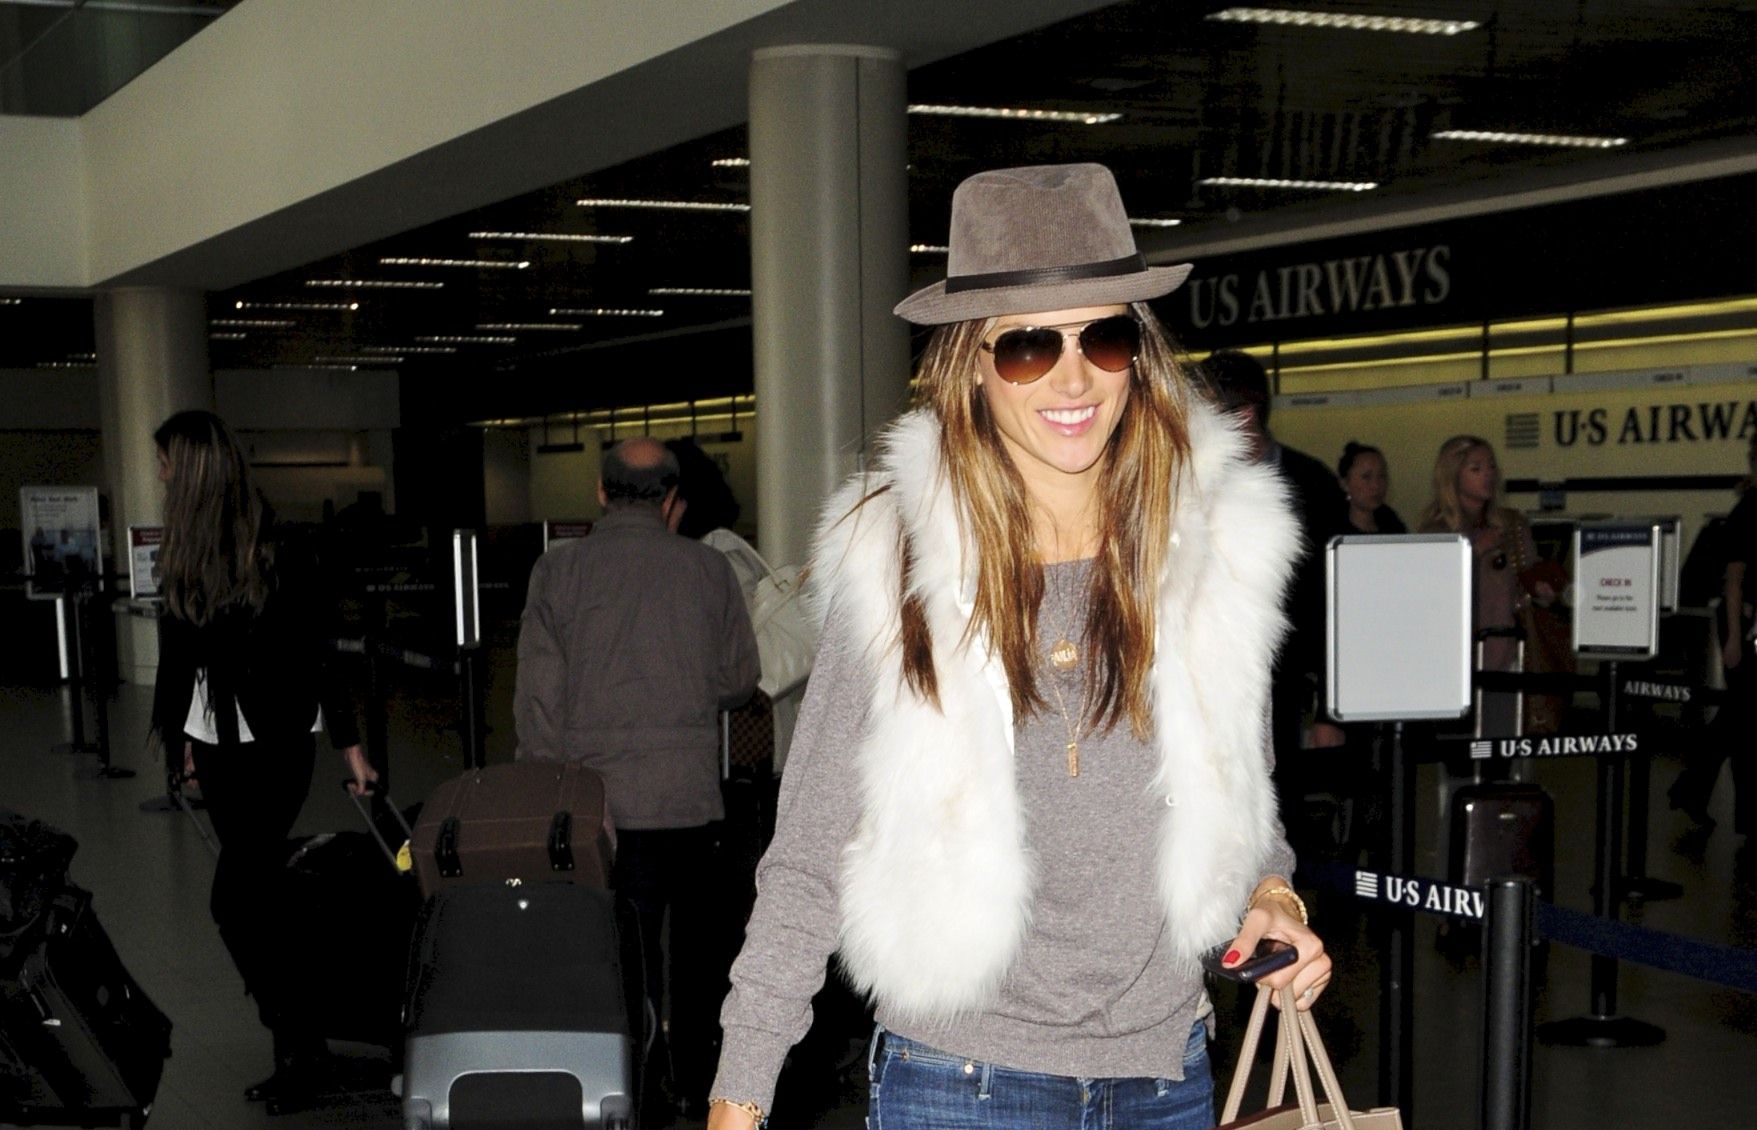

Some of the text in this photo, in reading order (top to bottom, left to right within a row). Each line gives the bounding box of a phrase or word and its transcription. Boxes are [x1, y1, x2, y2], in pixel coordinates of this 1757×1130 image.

[1187, 244, 1451, 329] US AIRWAYS
[1623, 680, 1692, 702] AIRWAYS
[1537, 734, 1638, 756] AIRWAYS
